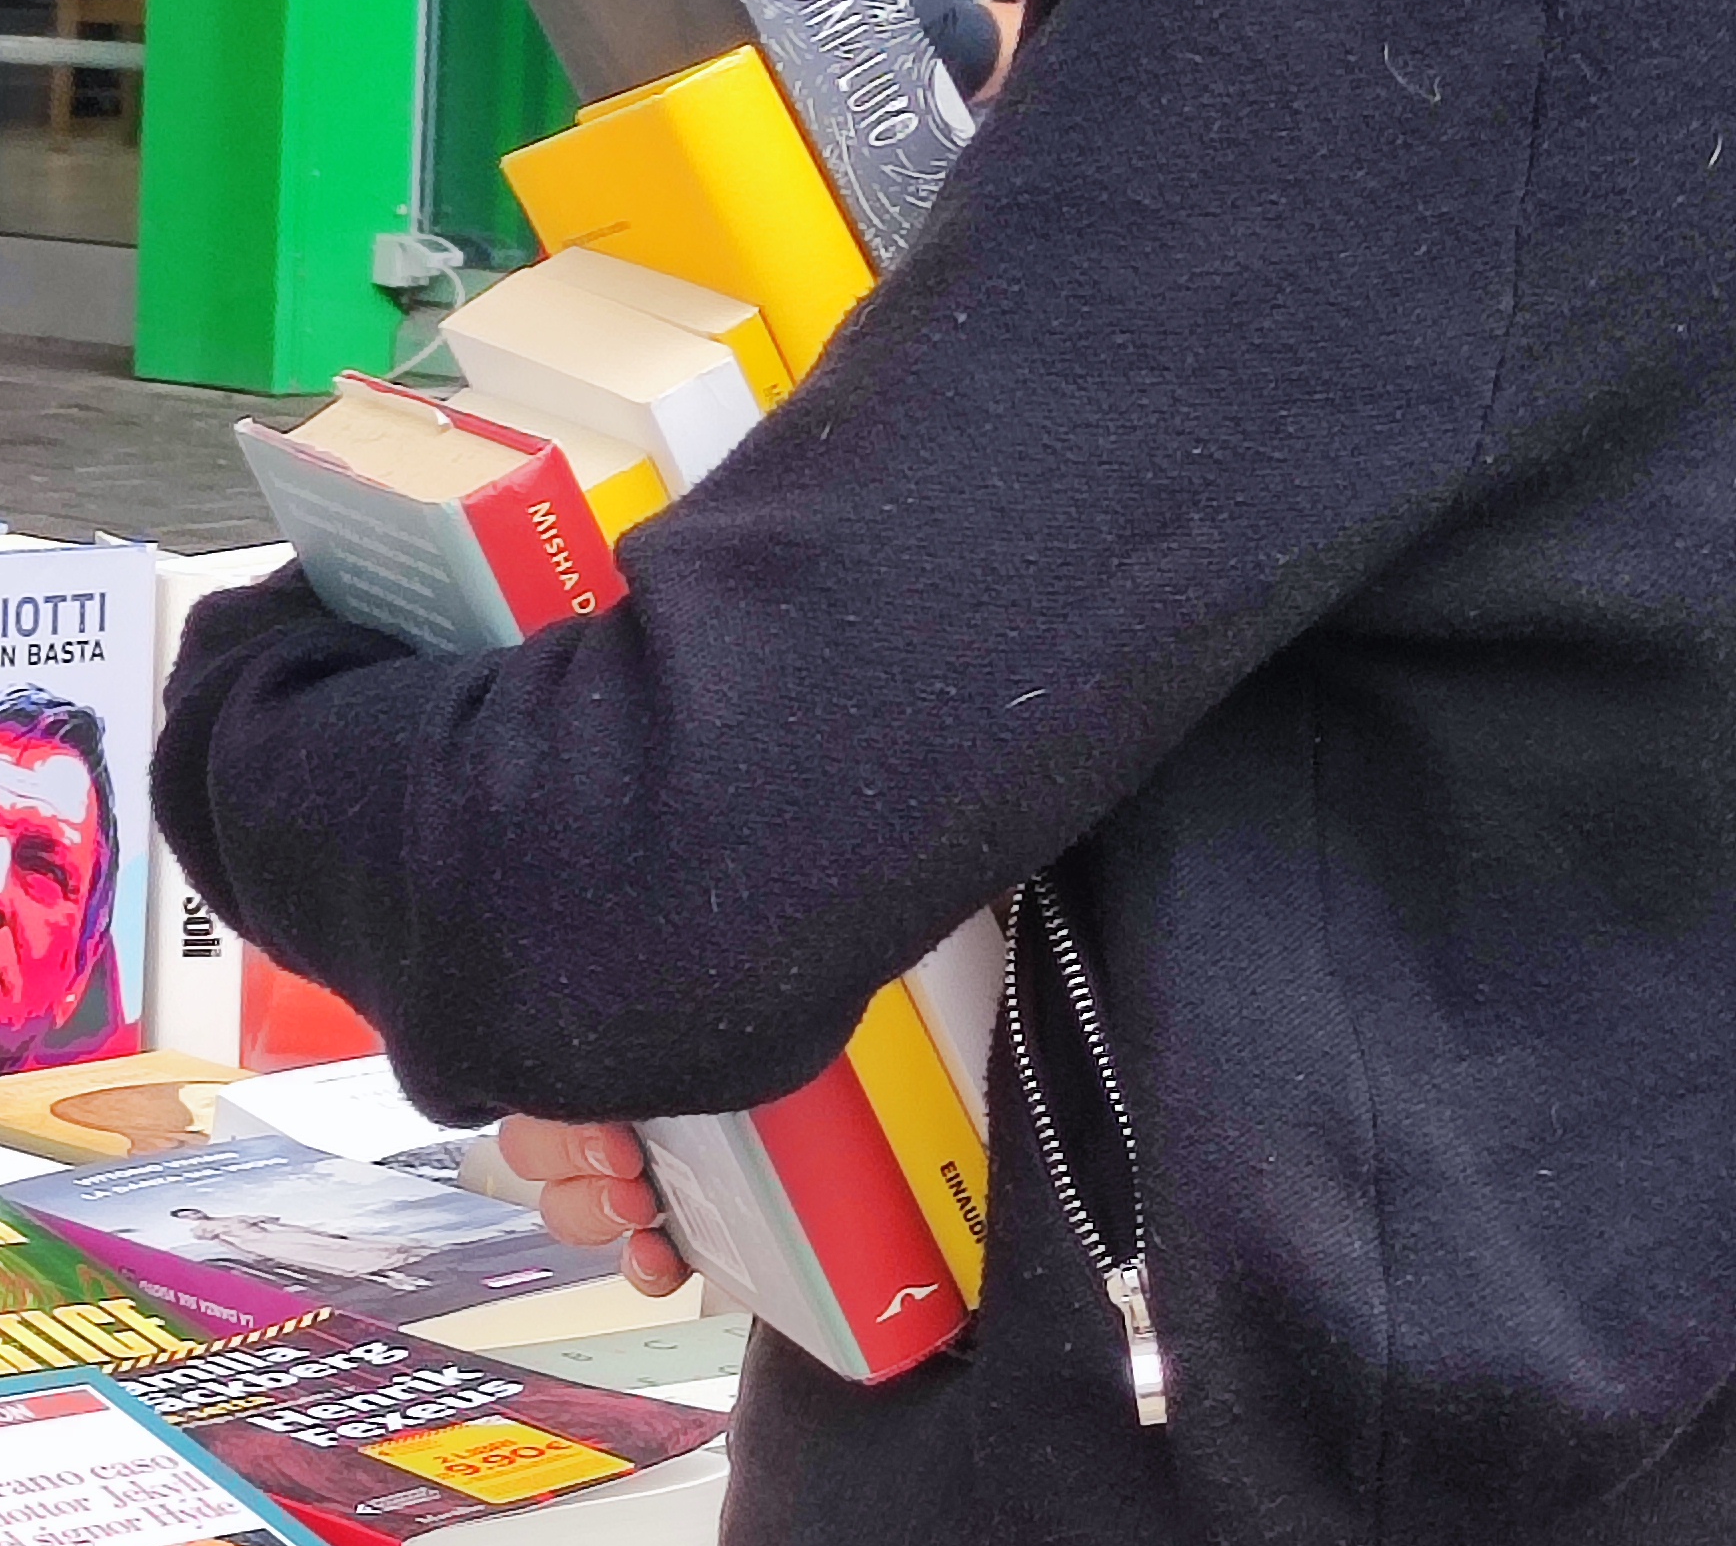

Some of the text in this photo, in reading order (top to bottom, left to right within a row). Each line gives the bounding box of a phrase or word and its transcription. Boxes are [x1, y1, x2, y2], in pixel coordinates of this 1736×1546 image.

[527, 500, 577, 592] MISHA
[27, 638, 106, 667] BASTA
[939, 1159, 988, 1245] EINAUDI
[119, 1343, 311, 1396] amilla
[246, 1363, 485, 1434] Henrik
[291, 1376, 524, 1448] Fexeus
[89, 1453, 180, 1483] caso
[101, 1471, 211, 1510] Jekyll
[142, 1497, 242, 1530] Hyde
